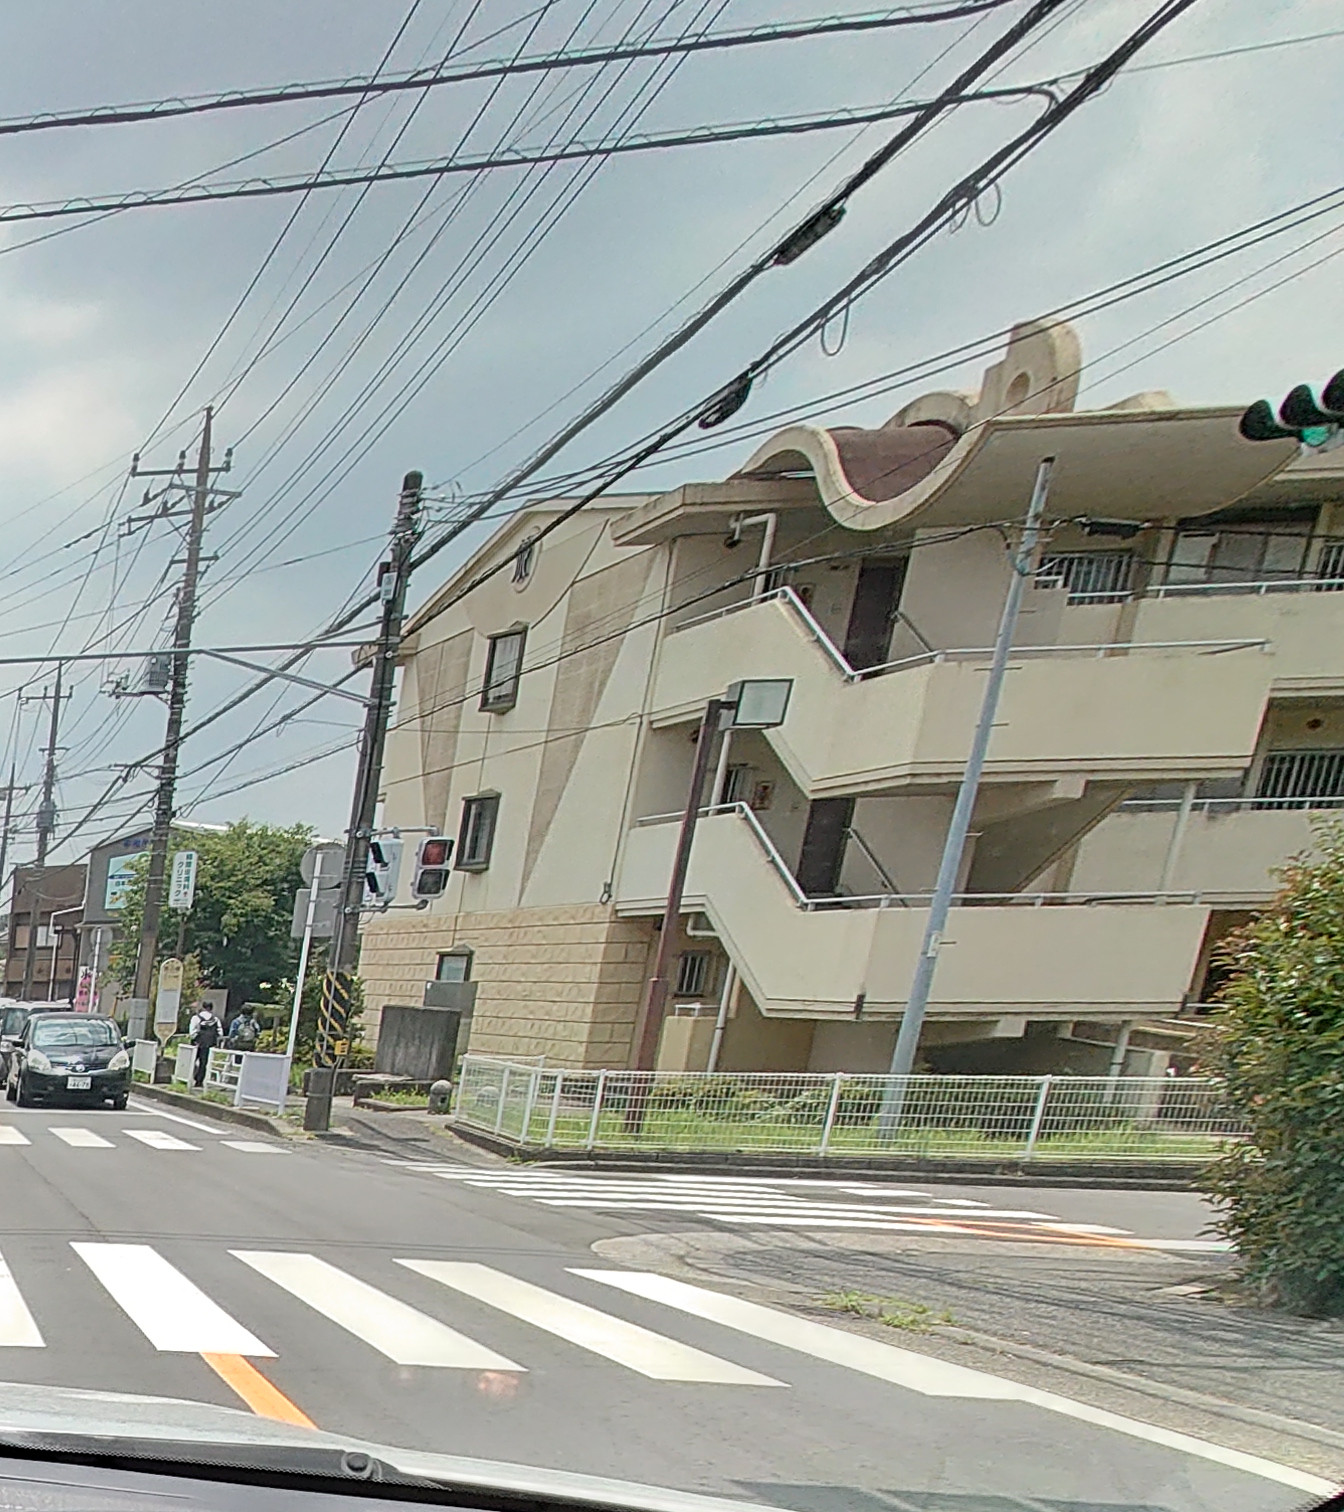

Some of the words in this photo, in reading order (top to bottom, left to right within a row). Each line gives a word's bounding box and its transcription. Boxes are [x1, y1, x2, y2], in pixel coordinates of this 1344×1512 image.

[174, 861, 184, 897] クリニック
